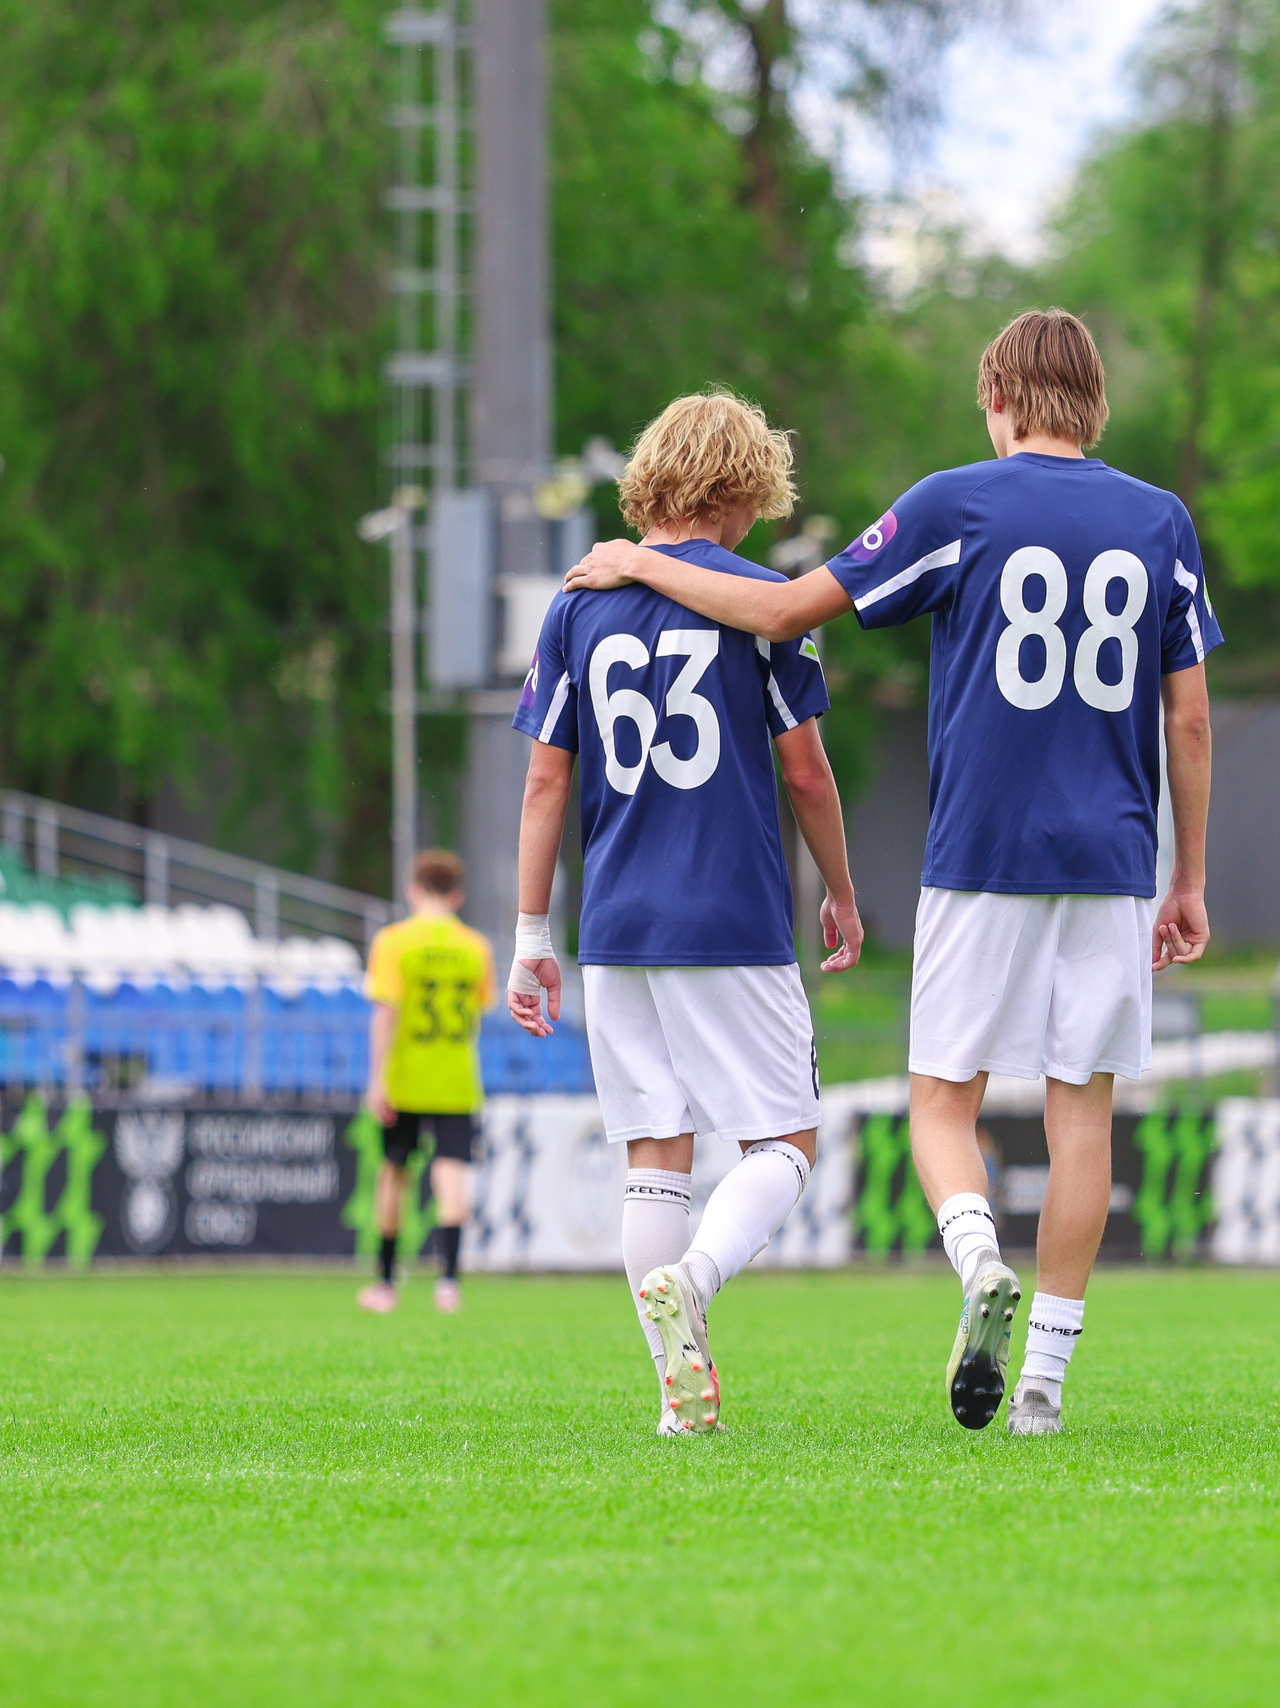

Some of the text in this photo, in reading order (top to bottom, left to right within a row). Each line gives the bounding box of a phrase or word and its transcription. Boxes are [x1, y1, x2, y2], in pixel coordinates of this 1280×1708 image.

[995, 545, 1149, 713] 88
[589, 629, 720, 795] 63
[629, 1186, 682, 1198] KELME
[941, 1209, 982, 1233] KELME
[1029, 1319, 1072, 1336] KELME
